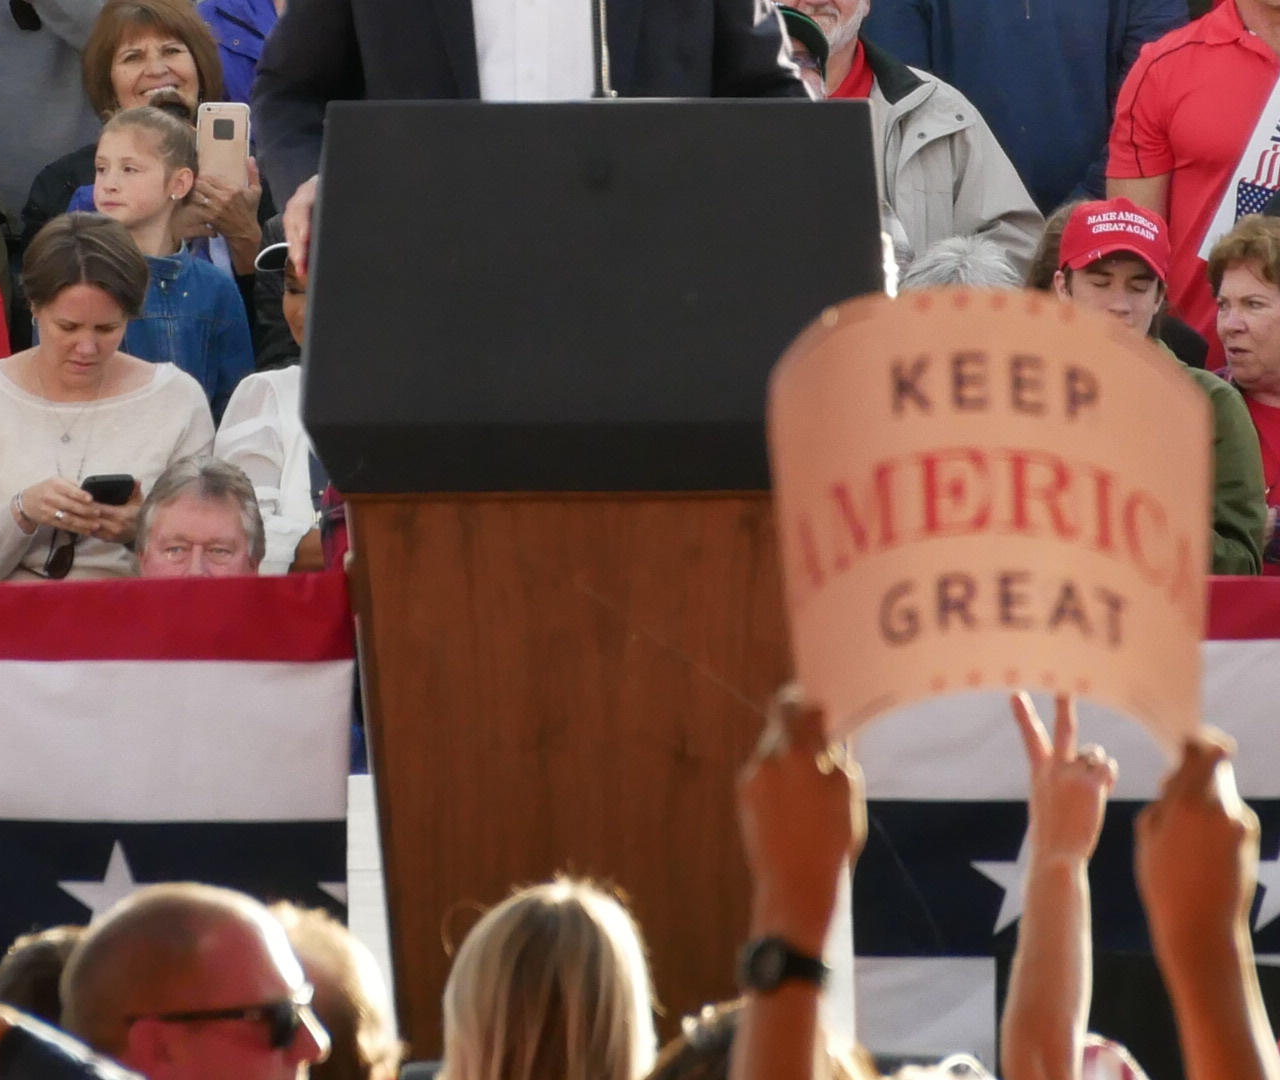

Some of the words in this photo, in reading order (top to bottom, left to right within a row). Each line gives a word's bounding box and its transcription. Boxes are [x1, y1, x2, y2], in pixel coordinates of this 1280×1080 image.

[1087, 213, 1117, 225] MAKE
[1117, 211, 1159, 234] AMERICA
[1092, 222, 1125, 233] GREAT
[1125, 223, 1155, 241] AGAIN
[890, 350, 1101, 421] KEEP
[879, 570, 1127, 651] GREAT
